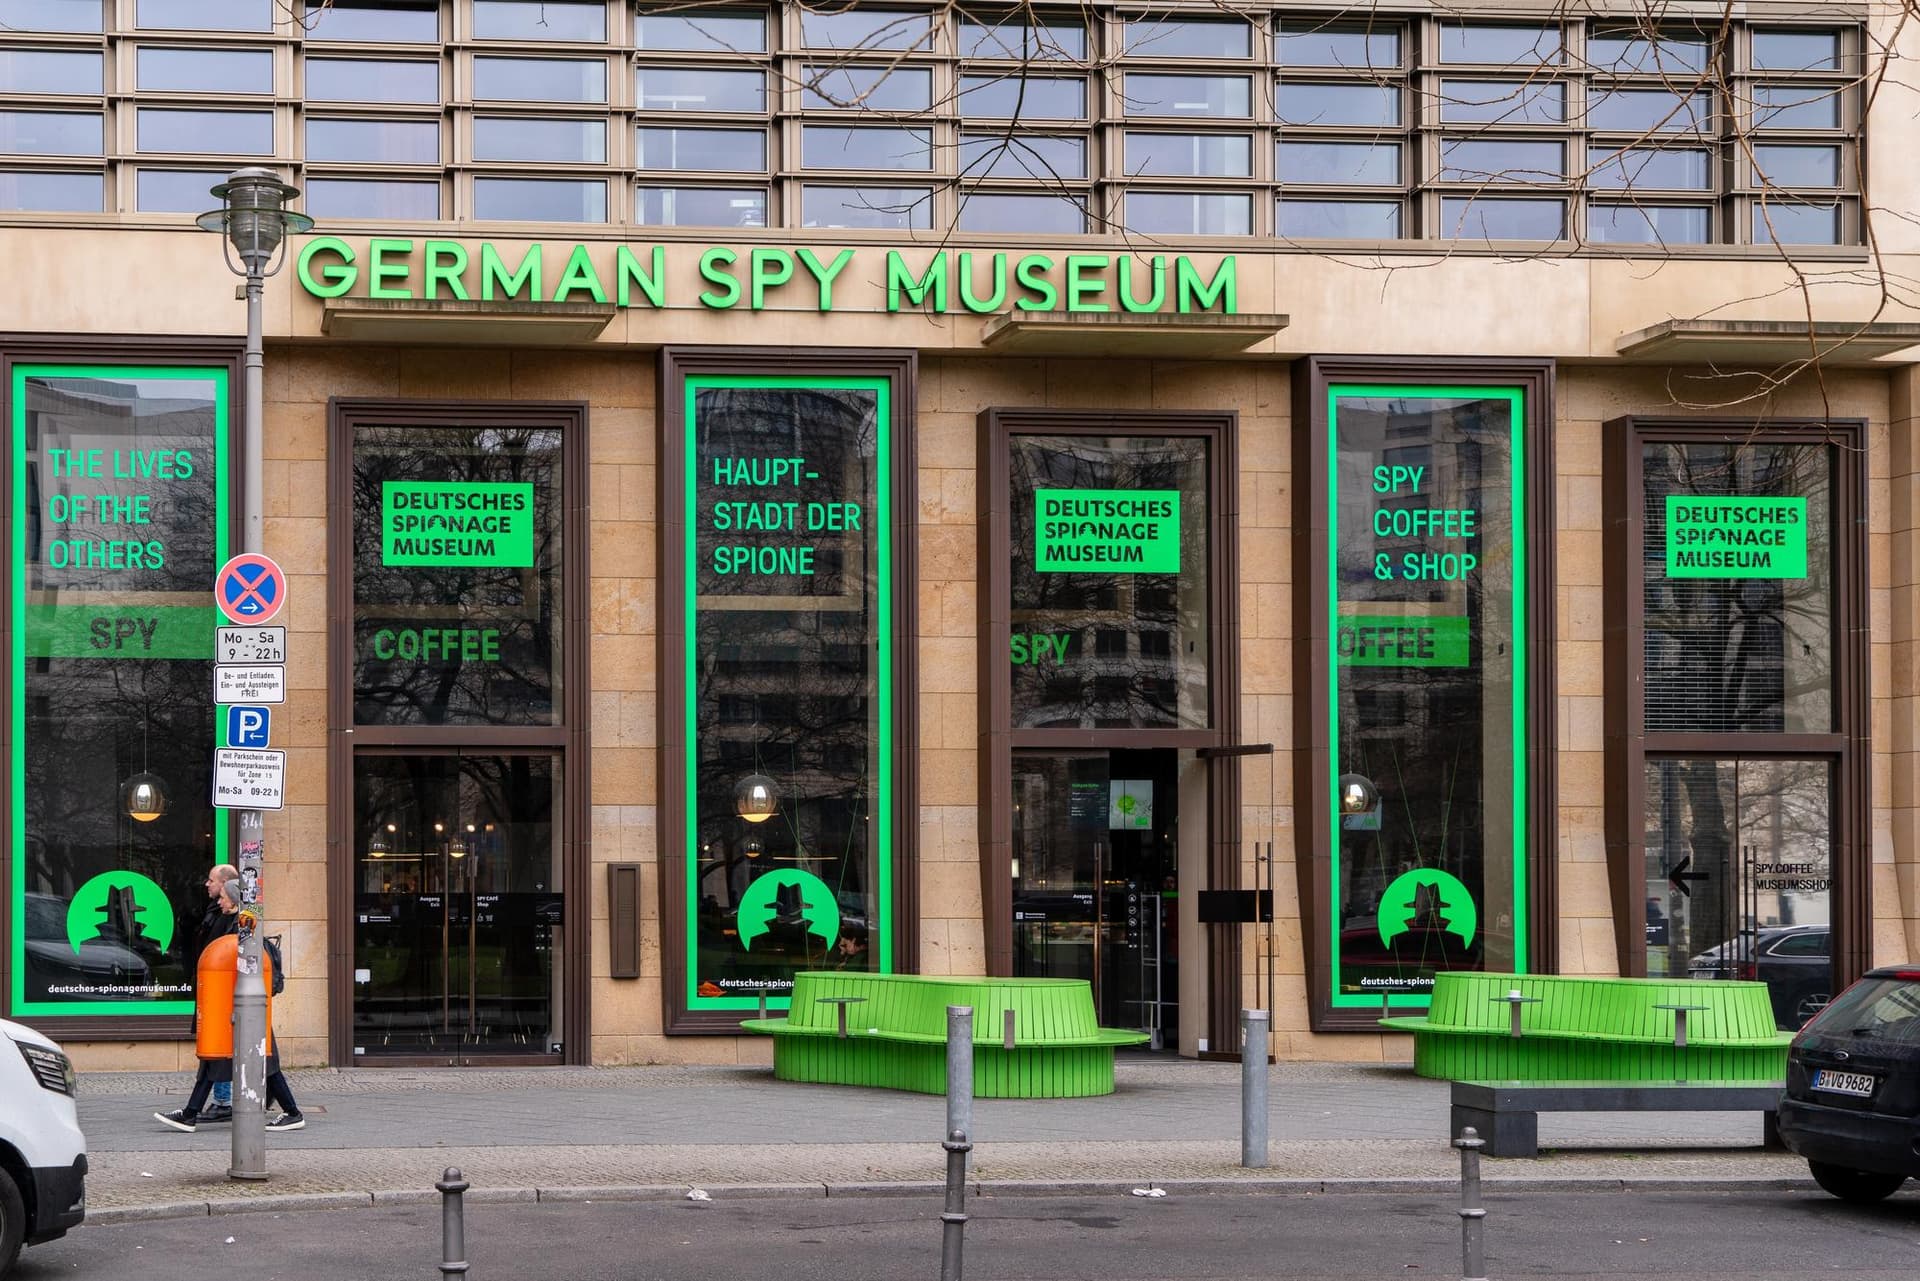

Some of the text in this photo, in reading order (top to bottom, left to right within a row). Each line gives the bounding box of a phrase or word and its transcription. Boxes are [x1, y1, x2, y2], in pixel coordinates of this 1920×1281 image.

[297, 236, 1237, 314] GERMAN SPY MUSEUM
[48, 449, 193, 480] THE LIVES
[713, 457, 819, 486] HAUPT-
[1372, 465, 1424, 493] SPY
[48, 494, 150, 524] OF THE
[392, 491, 526, 511] DEUTSCHES
[1045, 499, 1173, 518] DEUTSCHES
[392, 514, 512, 534] SPIONAGE
[713, 502, 861, 531] STADT DER
[1373, 509, 1476, 537] COFFEE
[1675, 506, 1799, 525] DEUTSCHES
[1045, 521, 1159, 541] SPIONAGE
[1675, 527, 1786, 547] SPIONAGE
[48, 539, 165, 570] OTHERS
[392, 538, 496, 557] MUSEUM
[1045, 544, 1144, 563] MUSEUM
[713, 546, 815, 575] SPIONE
[1374, 553, 1477, 581] & SHOP
[1675, 551, 1772, 569] MUSEUM
[90, 617, 159, 650] SPY
[224, 632, 242, 644] Mo
[259, 631, 274, 643] Sa
[1337, 626, 1435, 658] OFFEE
[228, 648, 236, 660] 9
[255, 648, 270, 659] 22
[273, 648, 280, 659] h
[373, 628, 500, 661] COFFEE
[1010, 633, 1070, 665] SPY
[241, 689, 259, 697] FREI
[248, 681, 279, 690] Aussteigen
[238, 711, 262, 743] P
[219, 761, 281, 770] Bewohnerparkausweis
[233, 752, 264, 761] Parkschein
[237, 770, 246, 778] für
[248, 770, 262, 778] Zone
[218, 786, 279, 797] Mo-Sa 09-22 h
[1755, 879, 1833, 890] MUSEUMSSHOP
[48, 983, 192, 994] deutsches-spionagemuseum.de
[1845, 1075, 1873, 1092] 9682
